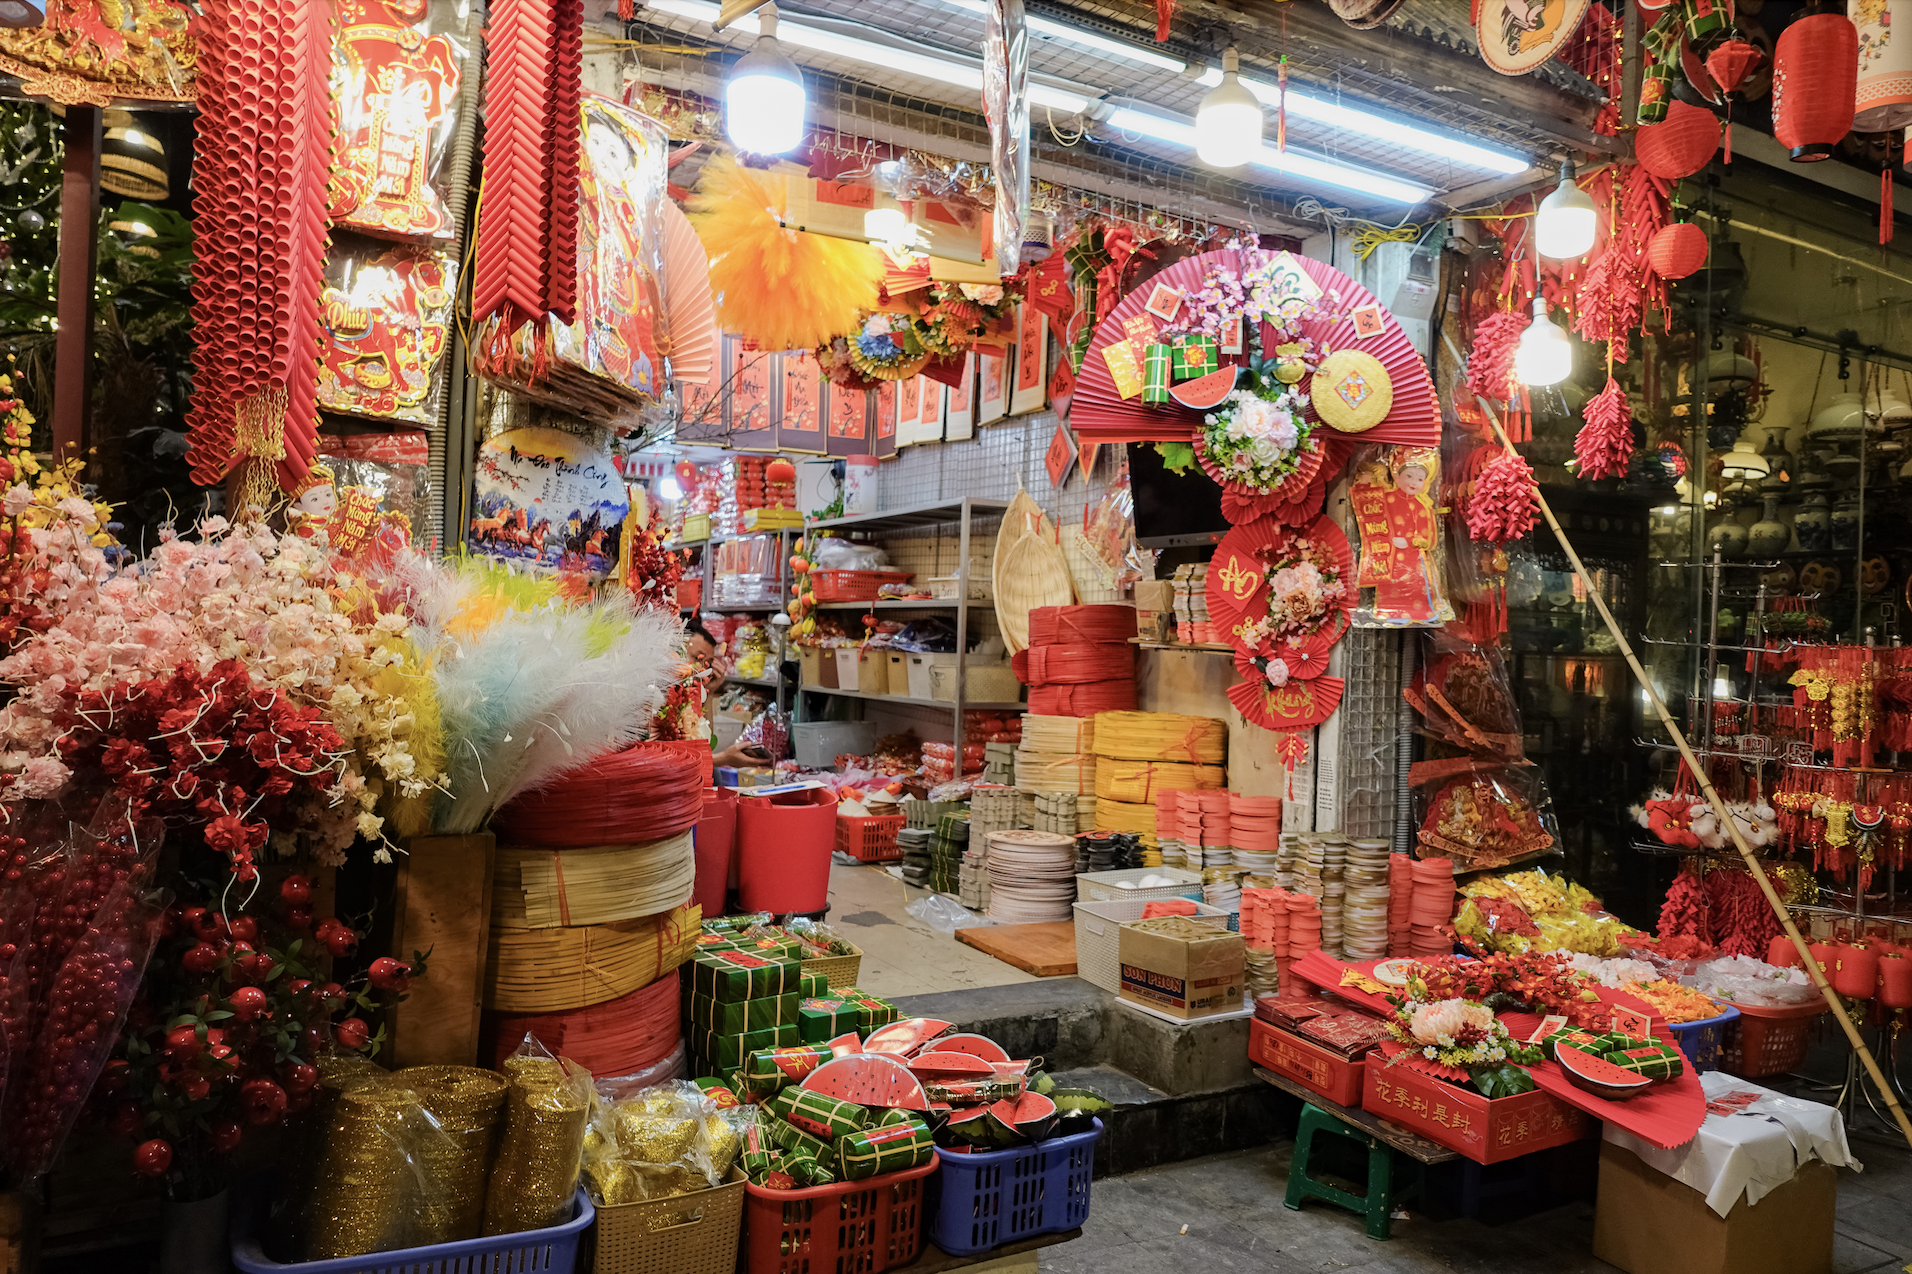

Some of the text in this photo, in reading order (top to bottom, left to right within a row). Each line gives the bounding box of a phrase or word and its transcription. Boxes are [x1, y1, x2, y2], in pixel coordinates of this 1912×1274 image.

[349, 494, 377, 510] Chúc
[1363, 500, 1384, 515] Chúc
[345, 504, 373, 527] Mừng
[341, 518, 366, 540] Năm
[1365, 519, 1389, 535] Mừng
[333, 532, 357, 551] Mới
[1375, 1078, 1473, 1136] 花季利是封
